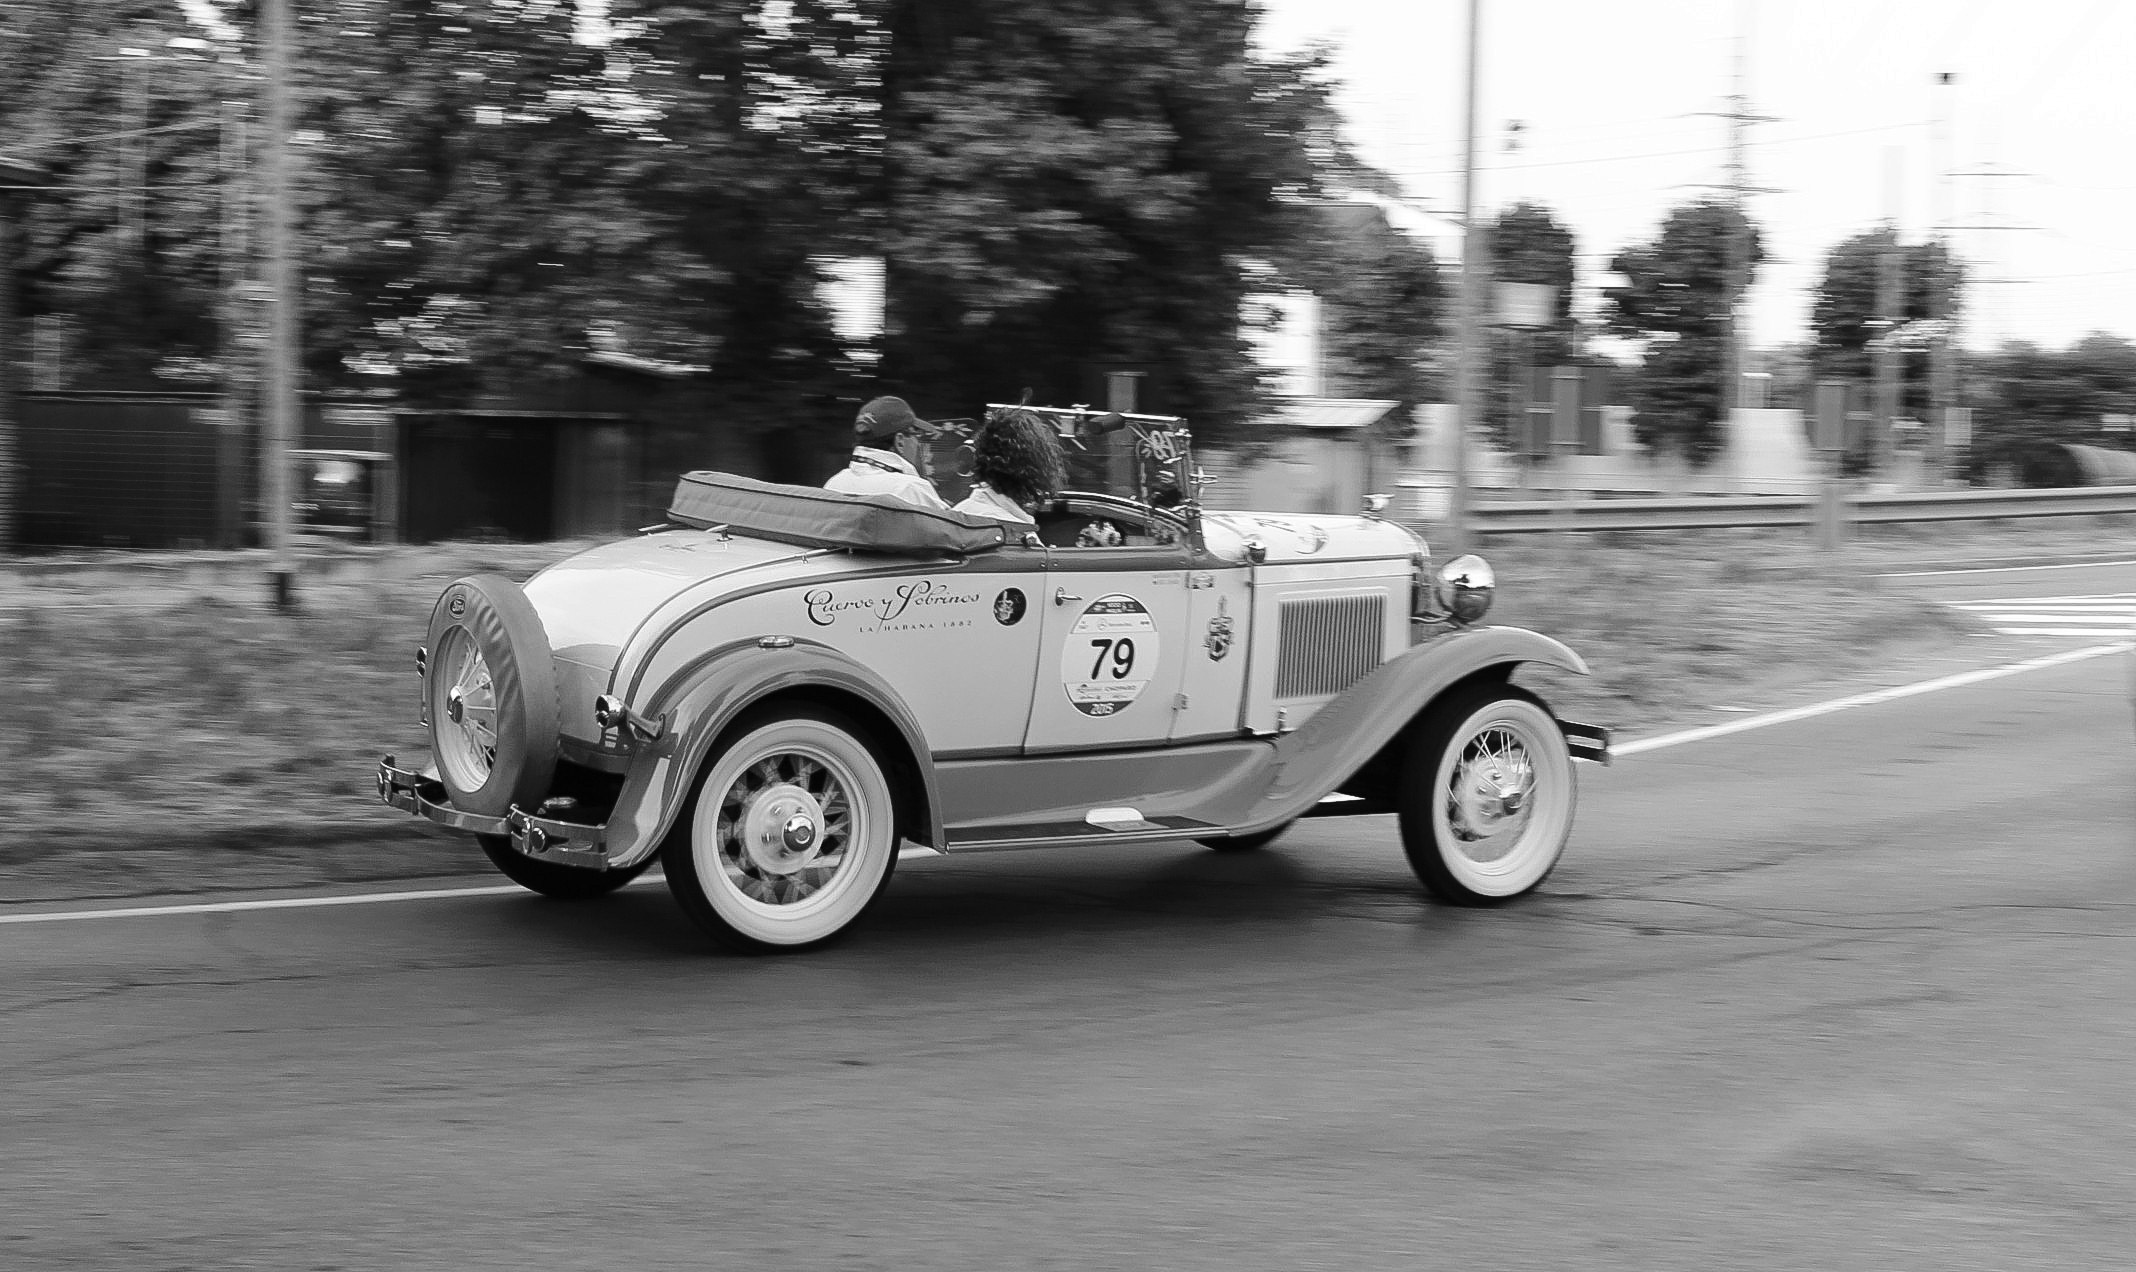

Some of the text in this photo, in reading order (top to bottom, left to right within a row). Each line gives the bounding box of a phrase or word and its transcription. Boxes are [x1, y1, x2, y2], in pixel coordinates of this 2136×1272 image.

[803, 580, 980, 633] Cuervo y Sobrinos
[884, 623, 934, 631] HABANA
[1091, 637, 1135, 680] 79
